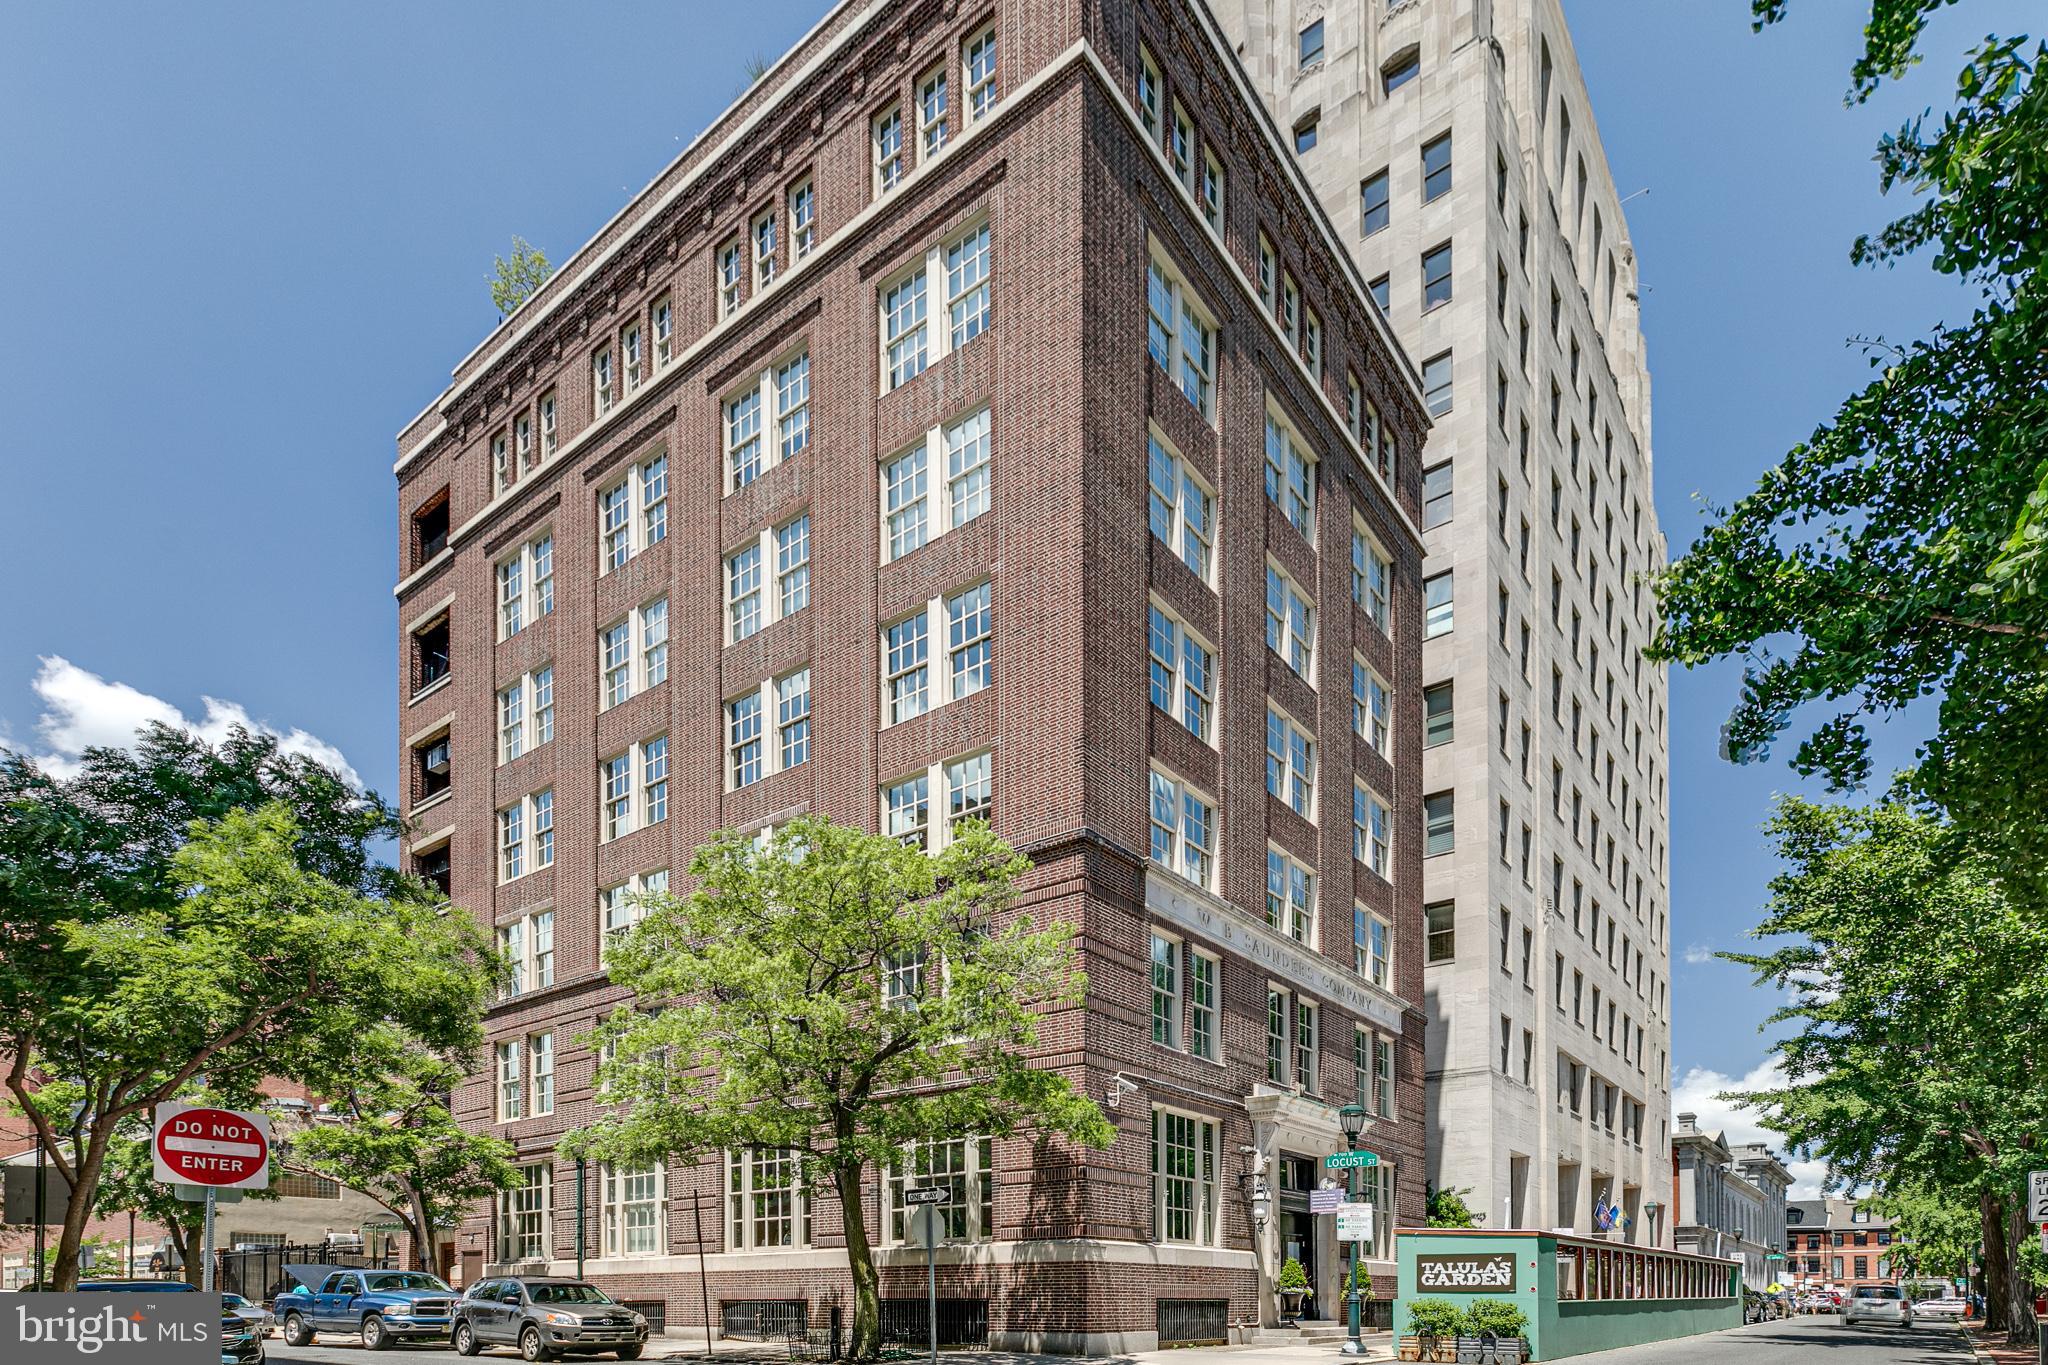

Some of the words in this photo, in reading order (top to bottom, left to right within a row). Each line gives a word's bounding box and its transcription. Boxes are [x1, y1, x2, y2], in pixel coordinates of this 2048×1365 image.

[1244, 934, 1313, 980] SAUNDERS
[1322, 975, 1372, 1010] COMPANY
[175, 1120, 203, 1135] DO
[212, 1125, 252, 1140] NOT
[181, 1155, 243, 1173] ENTER
[1327, 1156, 1364, 1168] LOCUST
[909, 1193, 922, 1201] ONE
[924, 1191, 937, 1200] WAY
[1421, 1272, 1512, 1287] GARDEN
